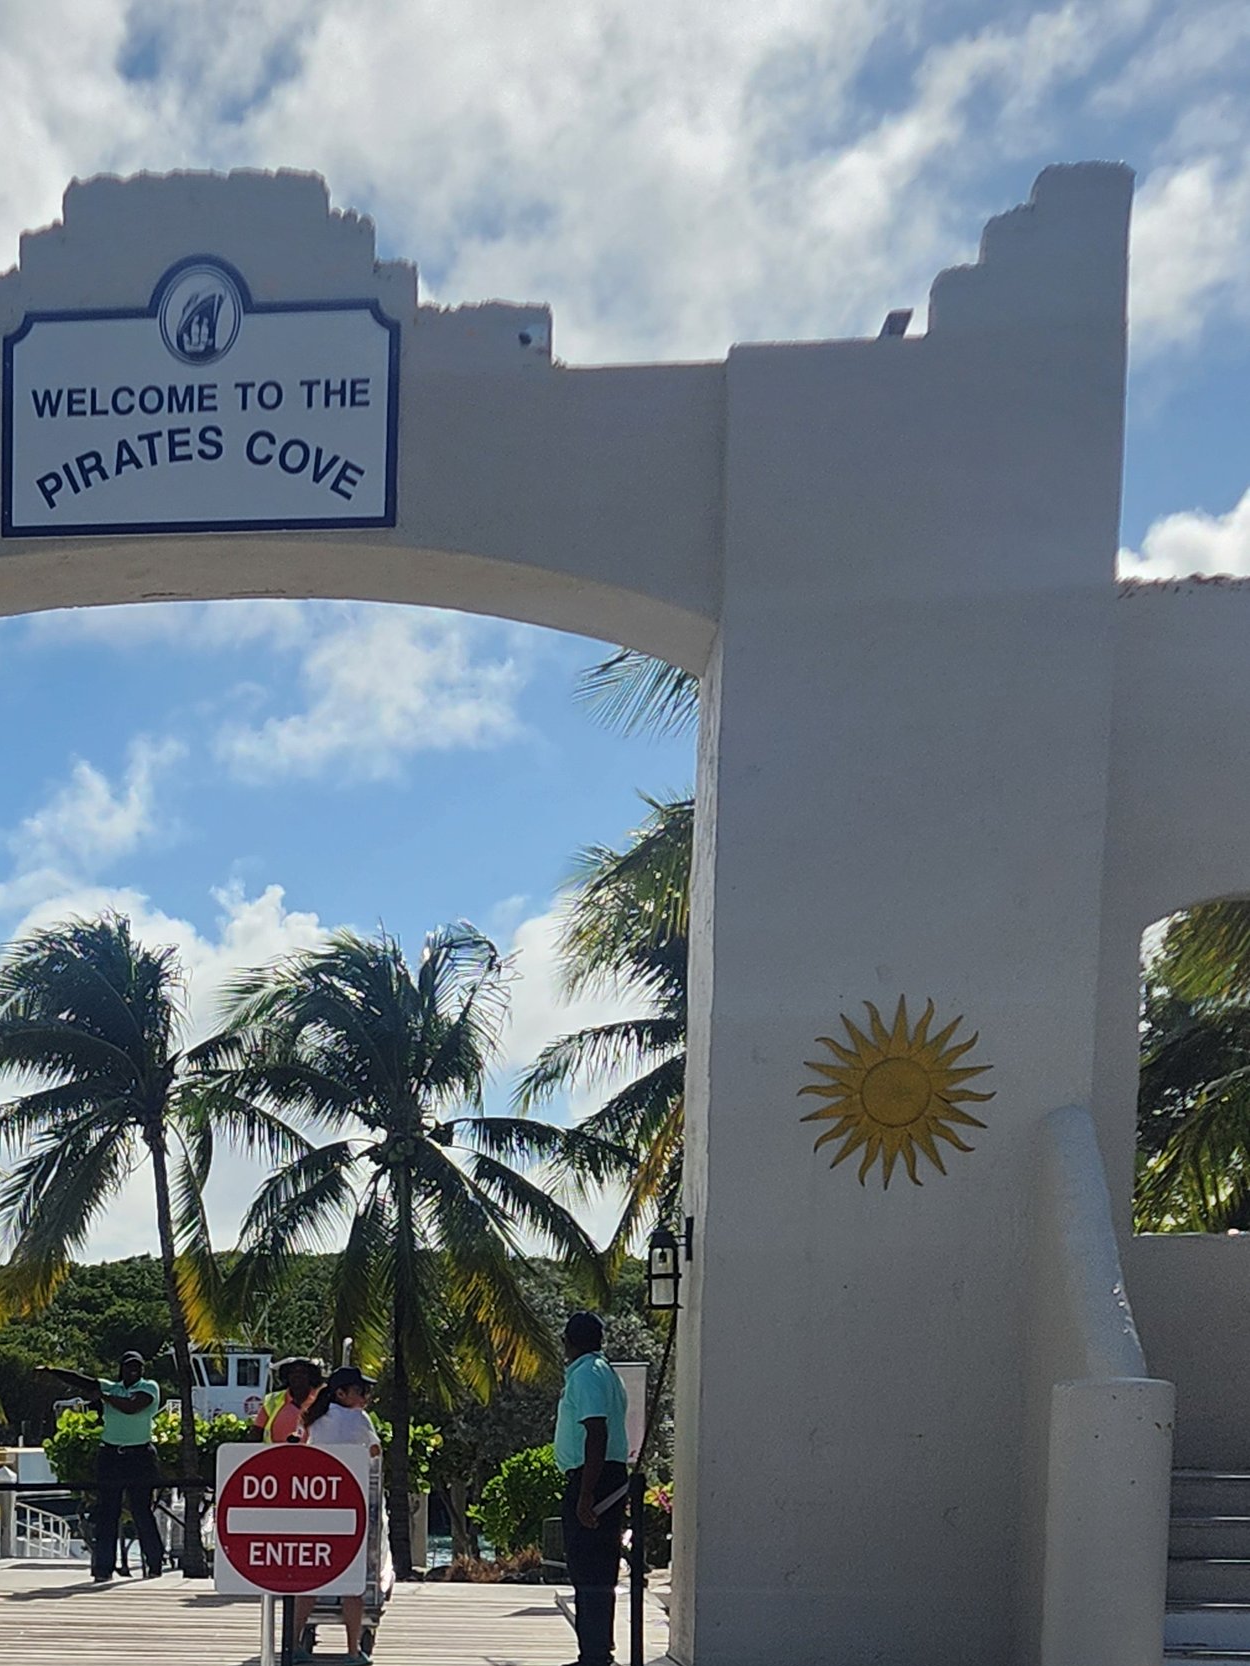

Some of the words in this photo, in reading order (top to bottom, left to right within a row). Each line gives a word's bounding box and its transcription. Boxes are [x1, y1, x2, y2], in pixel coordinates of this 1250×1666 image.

[31, 383, 218, 418] WELCOME
[234, 380, 283, 411] TO
[300, 377, 371, 409] THE
[36, 425, 224, 509] PIRATES
[245, 430, 366, 500] COVE
[242, 1475, 278, 1499] DO
[291, 1476, 342, 1500] NOT
[249, 1542, 332, 1567] ENTER
